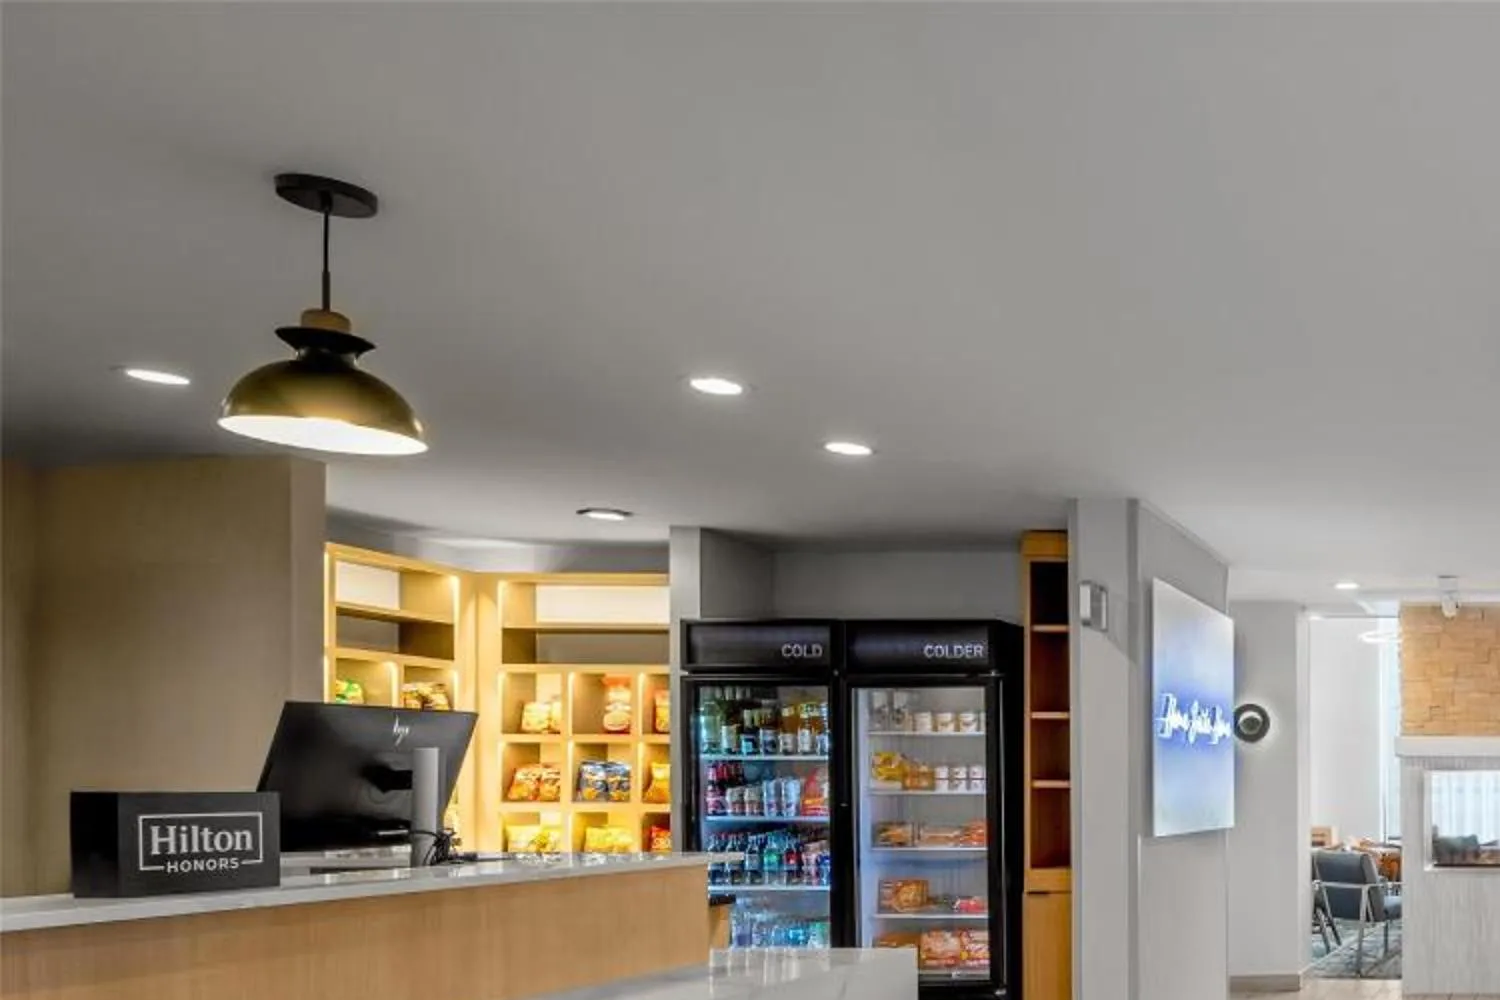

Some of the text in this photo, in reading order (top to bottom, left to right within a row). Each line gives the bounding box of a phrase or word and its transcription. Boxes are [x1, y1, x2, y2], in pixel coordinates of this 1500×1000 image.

[781, 643, 823, 658] COLD
[923, 644, 984, 659] COLDER
[150, 825, 253, 855] Hilton
[166, 857, 239, 873] HONORS
